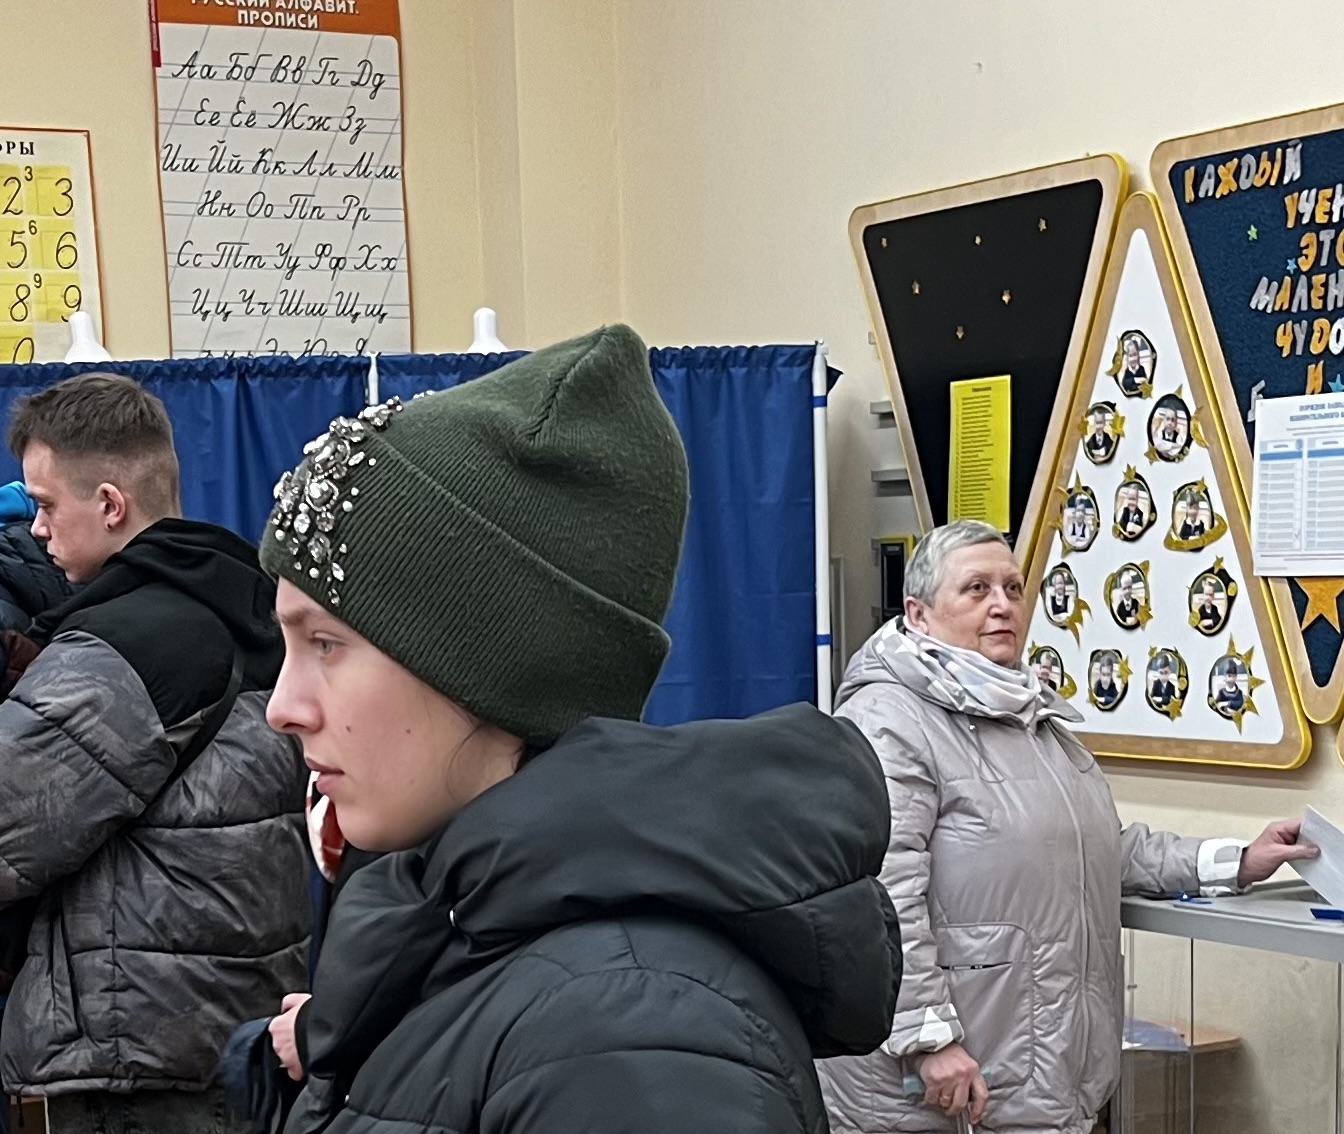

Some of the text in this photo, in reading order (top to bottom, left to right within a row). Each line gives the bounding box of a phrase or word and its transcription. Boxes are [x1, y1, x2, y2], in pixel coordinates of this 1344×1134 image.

[237, 10, 319, 29] ПРОПИСИ
[2, 176, 23, 215] 2
[24, 166, 33, 181] 3
[52, 177, 74, 216] 3
[1184, 139, 1302, 203] КАЖДЫЙ
[7, 230, 28, 269] 5
[28, 220, 38, 235] 6
[56, 231, 78, 269] 6
[9, 284, 31, 322] 8
[33, 273, 42, 288] 9
